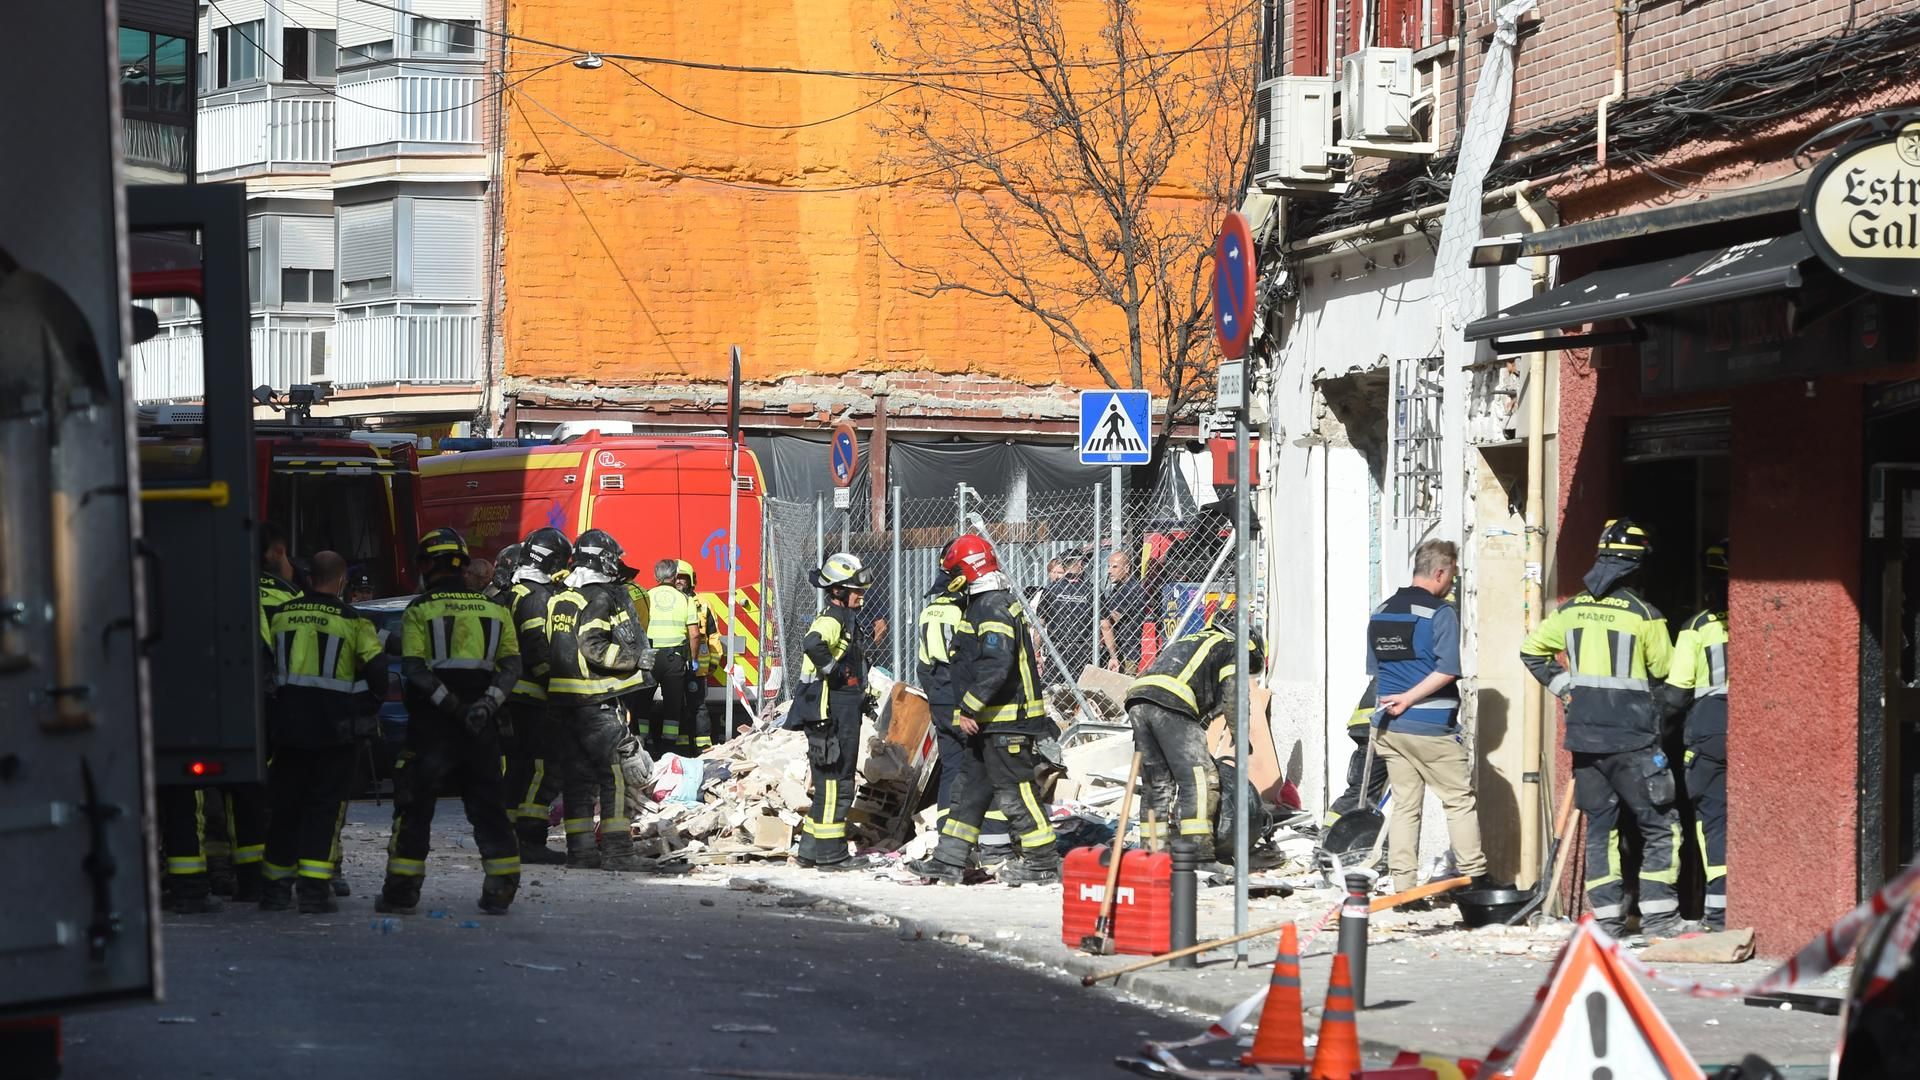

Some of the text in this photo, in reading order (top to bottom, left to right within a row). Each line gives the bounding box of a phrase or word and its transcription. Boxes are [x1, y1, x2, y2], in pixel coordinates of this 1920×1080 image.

[1841, 168, 1920, 206] Estr
[1848, 209, 1919, 249] Gal
[431, 592, 487, 600] BOMBEROS
[1573, 595, 1630, 608] BOMEROS
[283, 603, 342, 615] BOMBEROS
[287, 615, 329, 626] MADRID
[1577, 612, 1616, 623] MADRID
[1080, 883, 1135, 905] HITI
